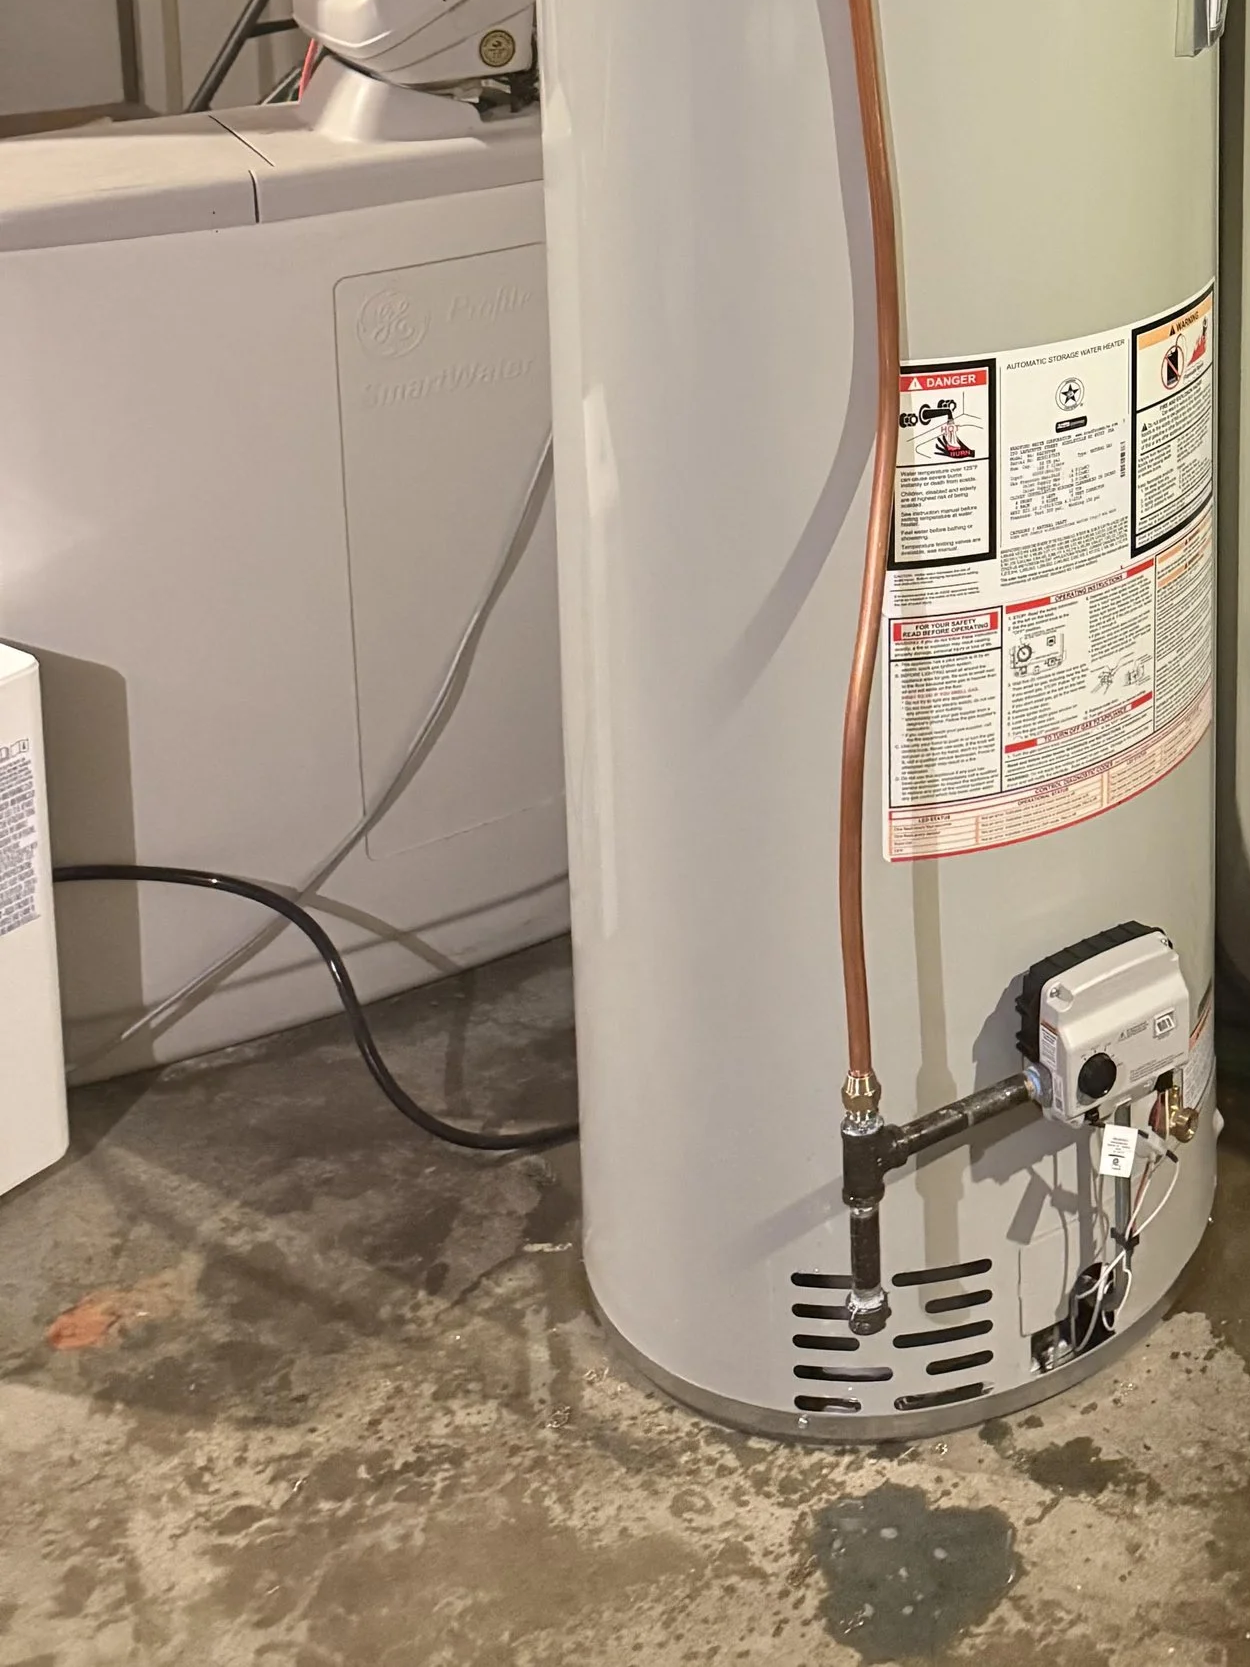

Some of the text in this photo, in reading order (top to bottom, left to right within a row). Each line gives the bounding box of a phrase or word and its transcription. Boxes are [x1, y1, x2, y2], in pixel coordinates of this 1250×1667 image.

[1176, 311, 1199, 332] WARNING
[1006, 339, 1125, 370] AUTOMATIC STORAGE WATER HEATER
[927, 374, 976, 388] DANGER
[1054, 575, 1123, 603] OPERATING INSTRUCTIONS
[923, 628, 949, 636] BEFORE
[951, 622, 989, 633] OPERATING
[951, 618, 976, 626] SAFETY
[1044, 734, 1052, 742] TO
[1034, 761, 1113, 794] CONTROL DIAGNOSTIC CODES
